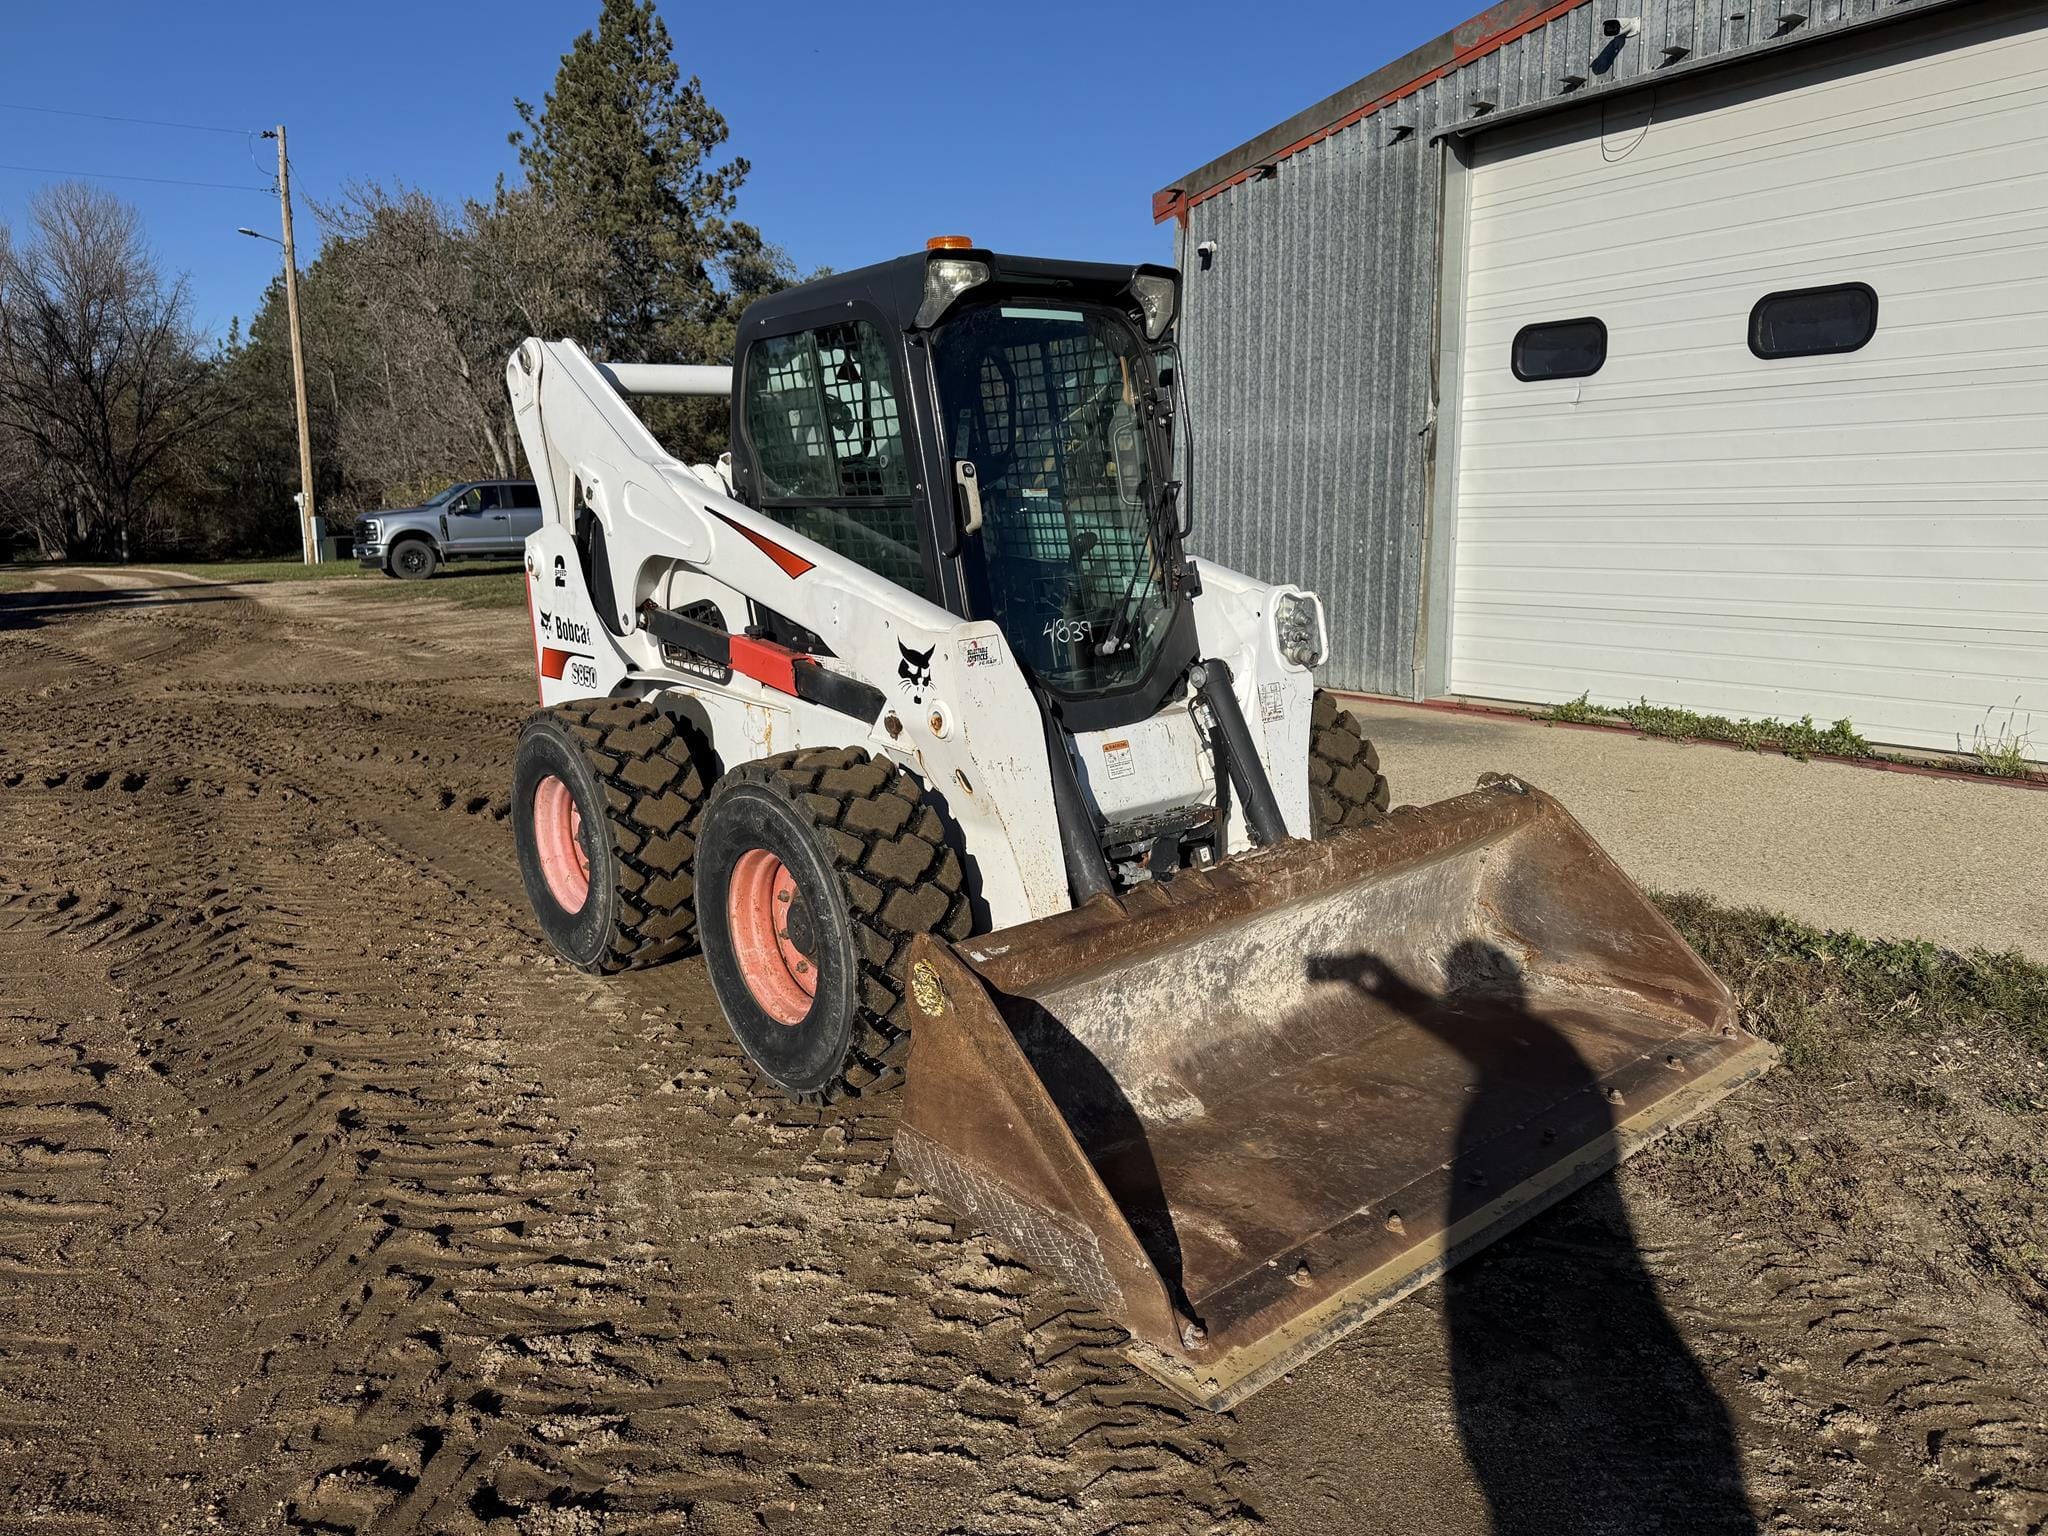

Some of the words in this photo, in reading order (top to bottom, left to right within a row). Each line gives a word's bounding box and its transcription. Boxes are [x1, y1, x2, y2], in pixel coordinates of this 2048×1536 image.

[554, 554, 566, 588] 2
[1042, 618, 1094, 644] 4839
[571, 662, 598, 689] S850
